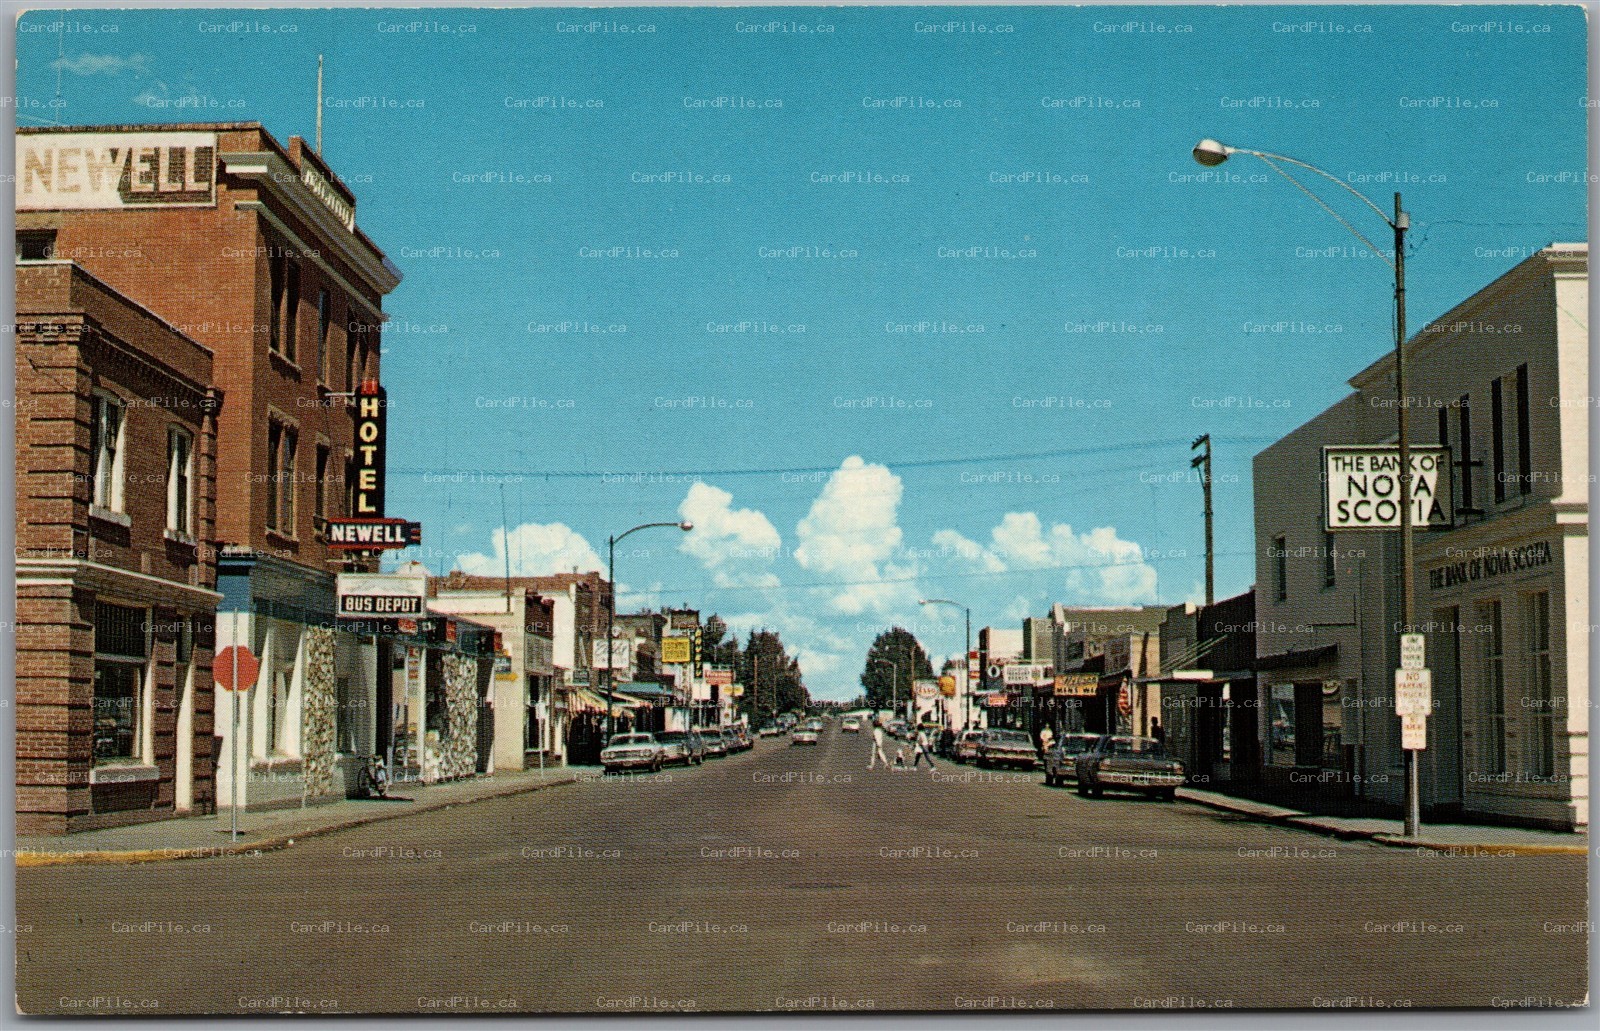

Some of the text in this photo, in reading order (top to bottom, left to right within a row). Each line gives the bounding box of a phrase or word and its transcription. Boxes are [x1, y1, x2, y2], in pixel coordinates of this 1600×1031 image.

[24, 147, 209, 193] NEWELL
[358, 397, 378, 513] HOTEL
[1332, 456, 1364, 472] THE
[1420, 455, 1444, 471] OF
[331, 524, 406, 543] NEWELL
[1429, 540, 1553, 589] THE BANK OF NOVA SCOTIA
[346, 596, 418, 613] BUS DEPOT
[1406, 673, 1420, 681] NO
